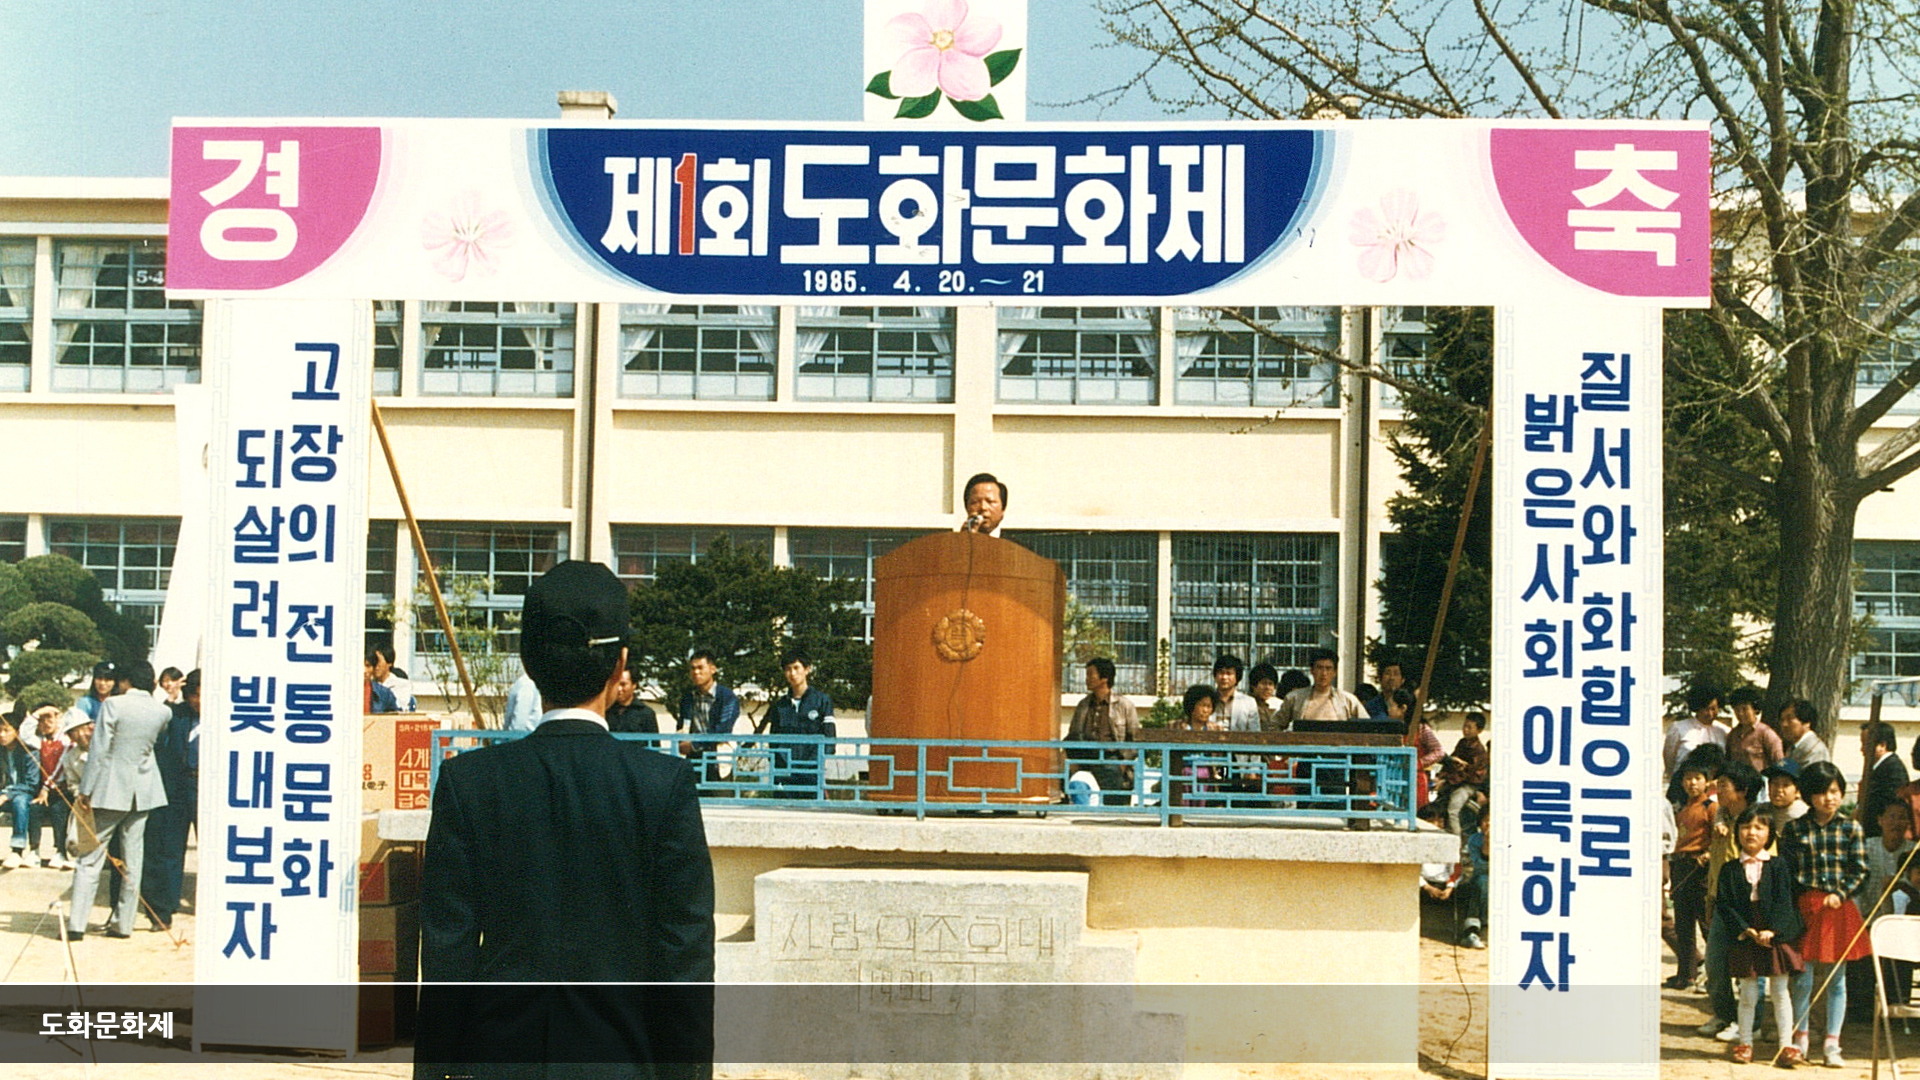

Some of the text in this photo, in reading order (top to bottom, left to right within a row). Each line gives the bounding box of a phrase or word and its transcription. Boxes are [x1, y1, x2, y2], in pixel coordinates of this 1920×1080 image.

[199, 140, 300, 261] 경
[601, 144, 1245, 264] 제1회 도화문화제
[803, 269, 867, 293] 1985.
[893, 269, 921, 293] 4.
[1567, 143, 1682, 267] 축
[222, 429, 285, 960] 되살려 빛내보자
[281, 342, 344, 898] 고장의 전통문화
[1579, 352, 1637, 878] 질서와 화합으로
[1517, 705, 1577, 993] 이룩하자
